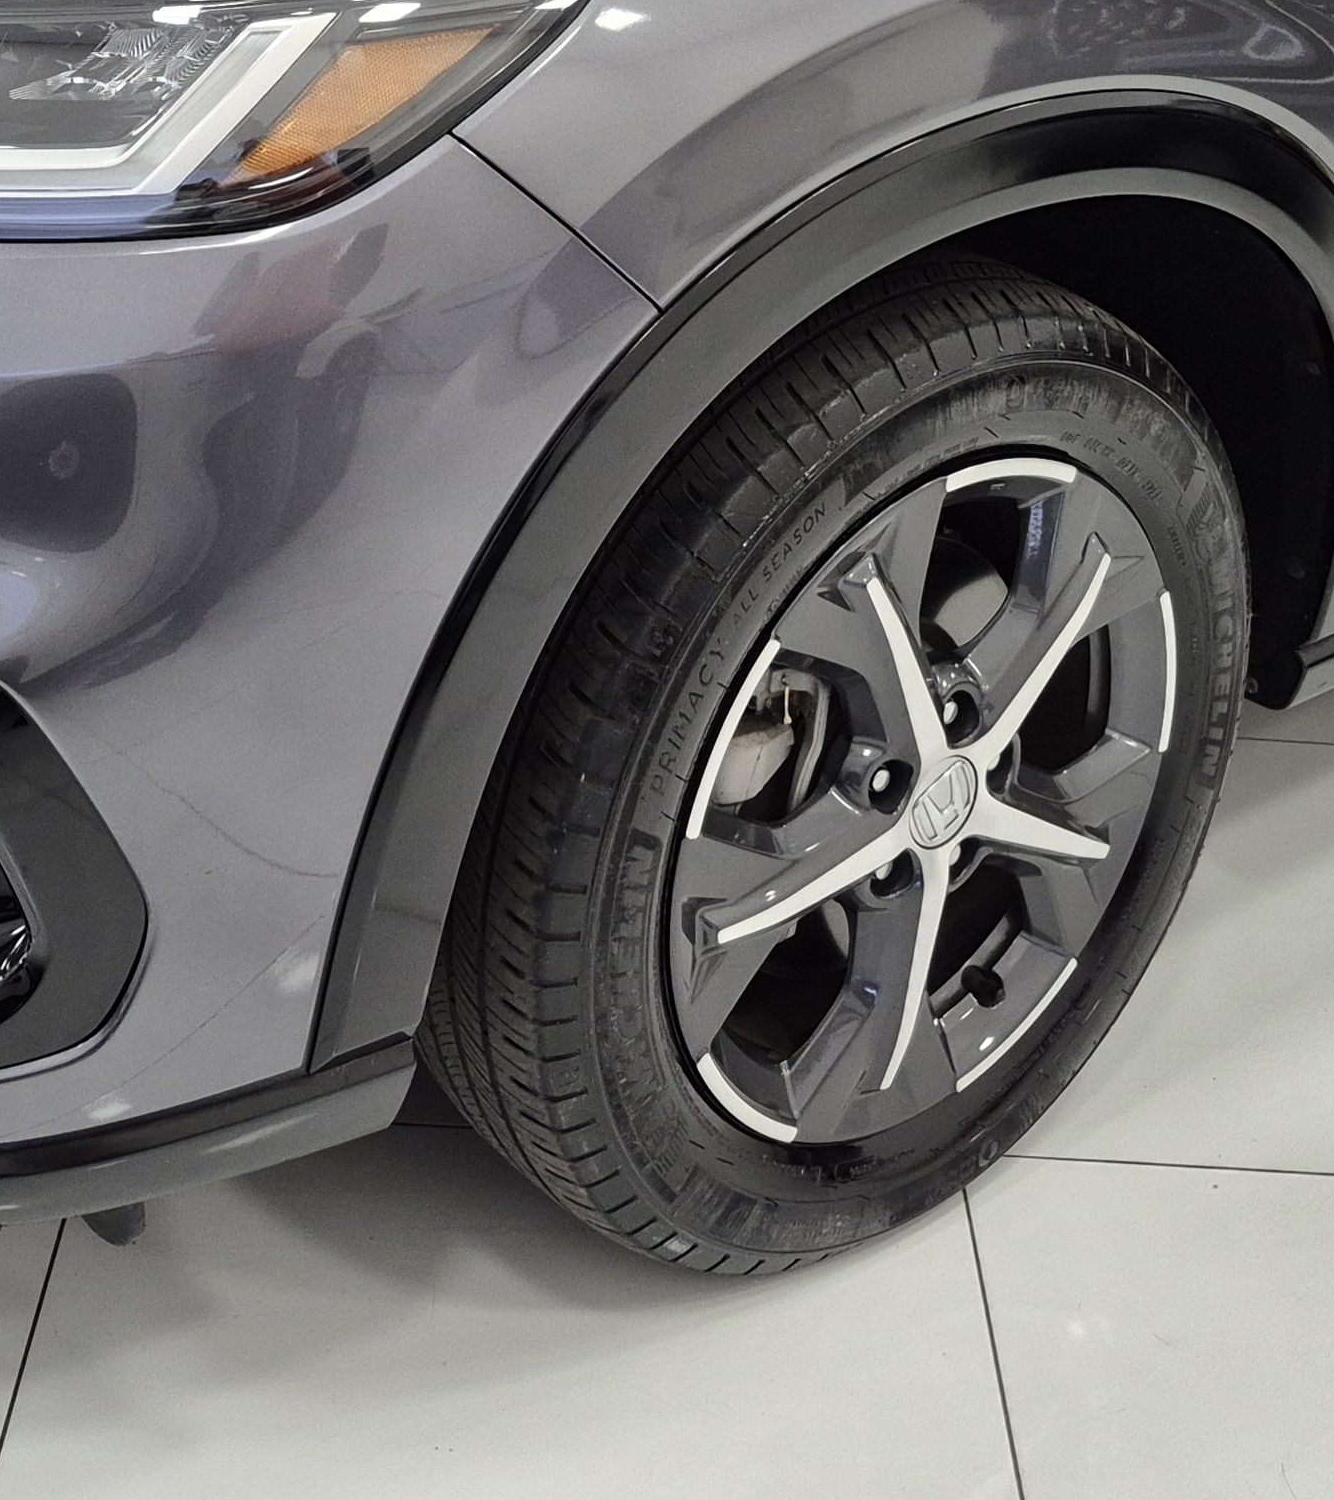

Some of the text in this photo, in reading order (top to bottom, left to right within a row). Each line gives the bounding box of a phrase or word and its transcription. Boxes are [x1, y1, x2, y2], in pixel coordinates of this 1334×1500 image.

[648, 634, 728, 798] PRIMACY
[731, 585, 761, 630] ALL
[761, 500, 828, 581] SEASON
